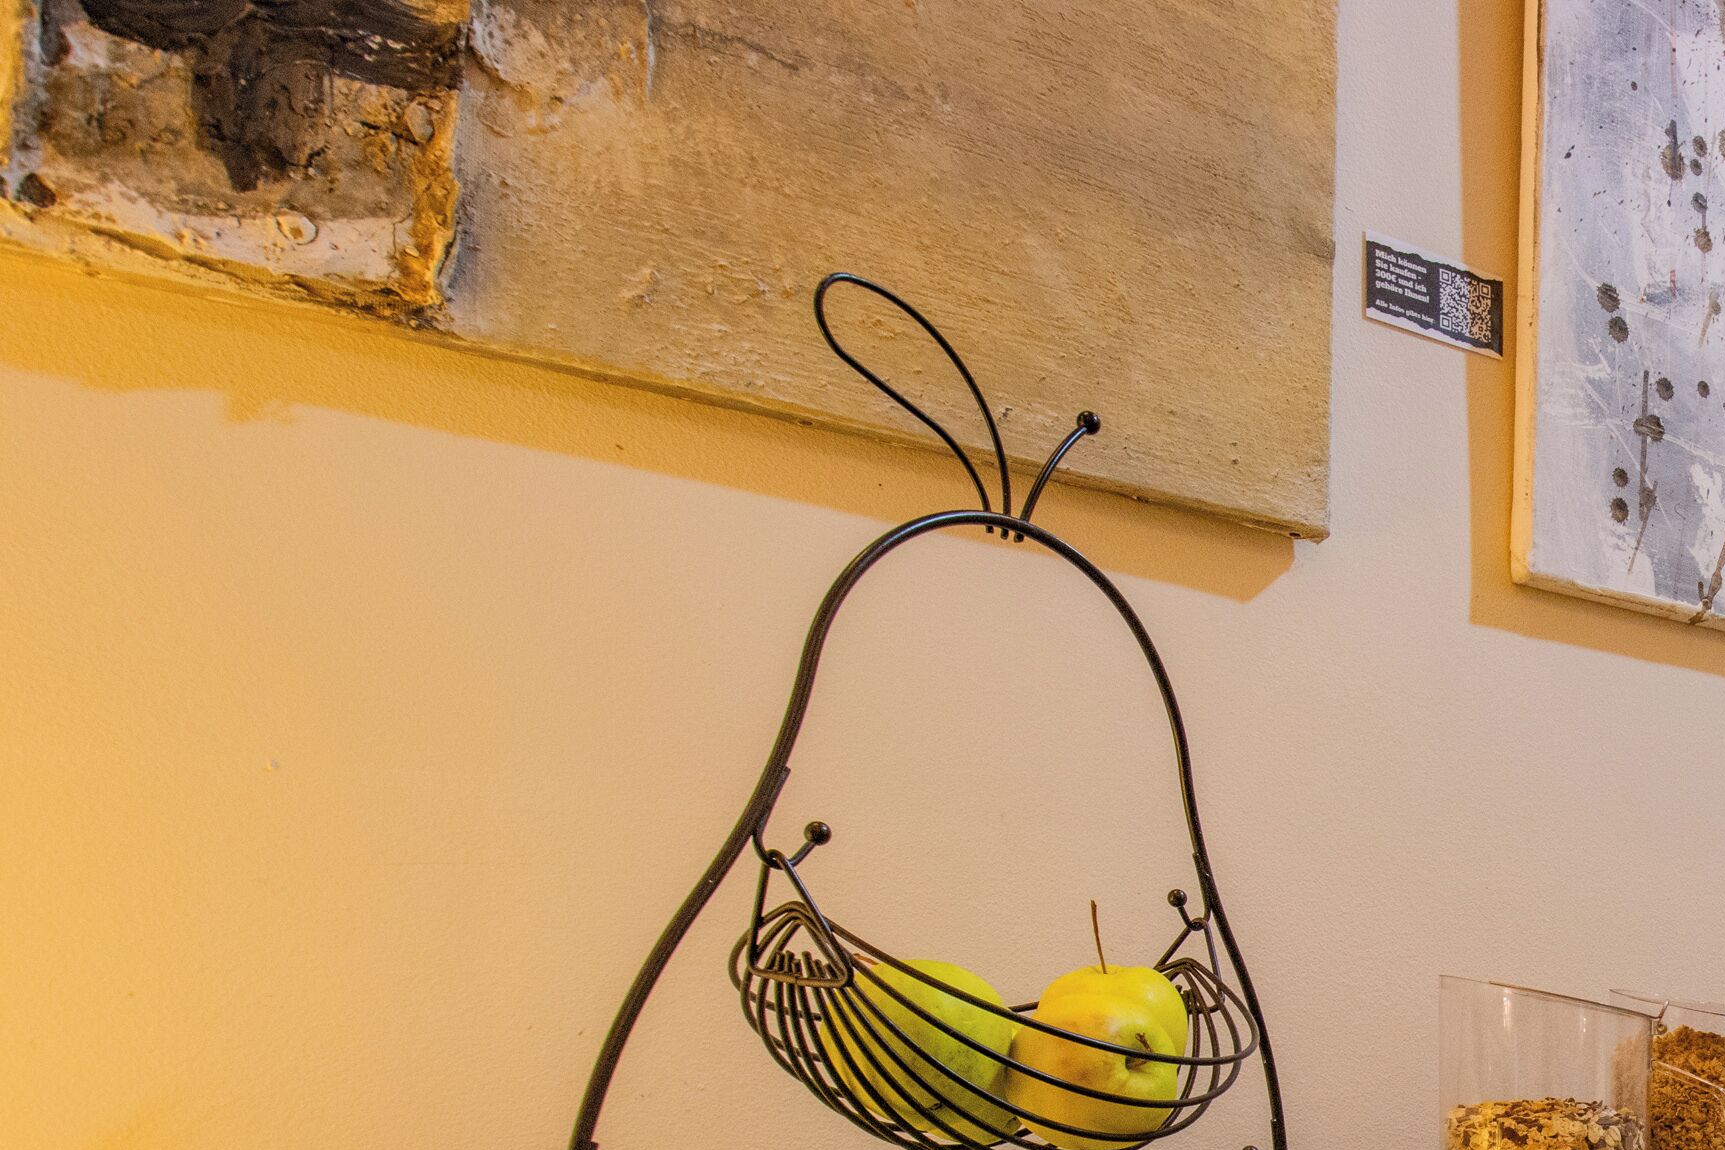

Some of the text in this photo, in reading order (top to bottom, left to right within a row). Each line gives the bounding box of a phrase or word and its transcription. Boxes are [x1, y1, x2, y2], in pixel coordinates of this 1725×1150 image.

[1375, 249, 1427, 274] Mich können
[1375, 259, 1389, 270] Sie
[1390, 264, 1417, 280] kaufen
[1375, 268, 1427, 293] 300€ und ich
[1375, 280, 1430, 303] gehöre Ihnen!
[1375, 298, 1388, 308] Alle
[1389, 302, 1405, 314] Infos
